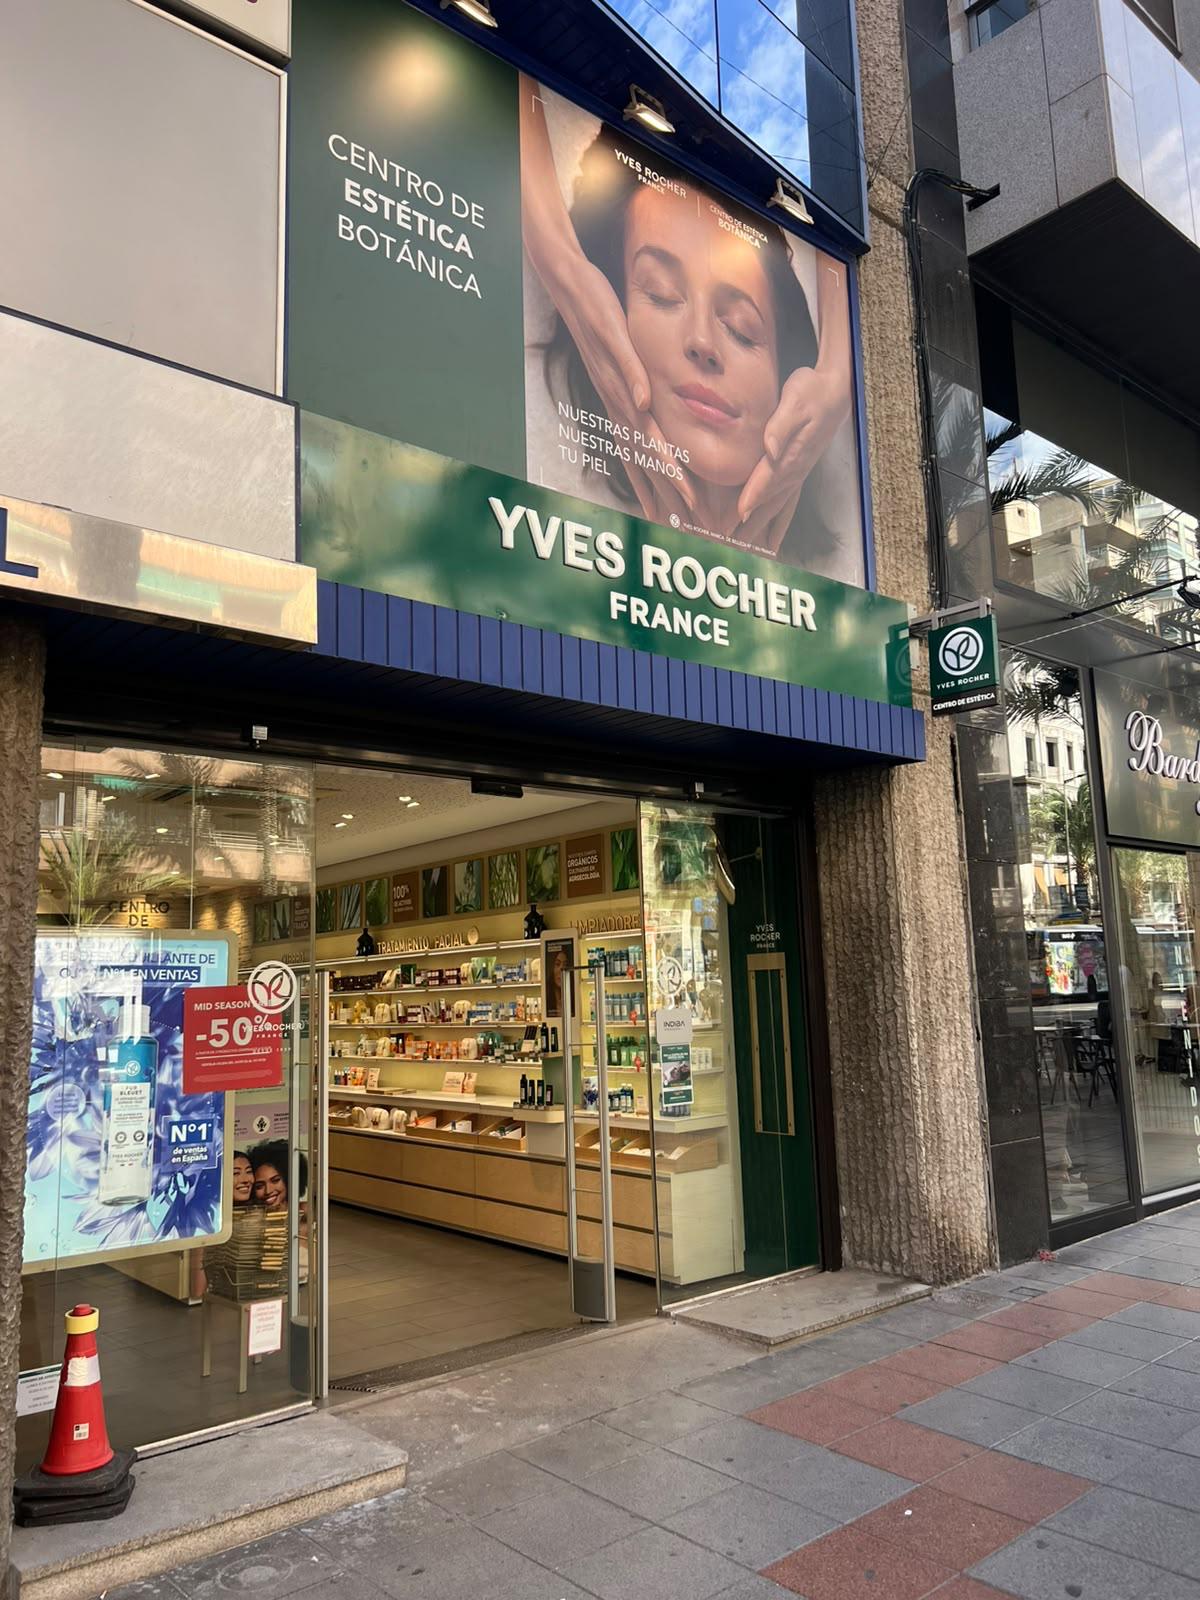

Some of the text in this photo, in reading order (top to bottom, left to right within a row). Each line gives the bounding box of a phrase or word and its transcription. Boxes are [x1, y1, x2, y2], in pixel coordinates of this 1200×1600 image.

[327, 134, 486, 230] CENTRO DE
[614, 148, 687, 199] YVES ROCHER
[638, 174, 665, 195] FRANCE
[344, 178, 474, 260] ESTÉTICA
[709, 203, 733, 223] CENTRO
[734, 217, 743, 229] DE
[718, 217, 761, 249] BOTÁNICA
[338, 214, 482, 300] BOTÁNICA
[558, 401, 690, 464] NUESTRAS PLANTAS
[558, 445, 611, 476] TU PIEL
[559, 423, 684, 481] NUESTRAS MANOS
[488, 496, 818, 632] YVES ROCHER
[609, 590, 730, 647] FRANCE
[936, 673, 990, 690] YVES ROCHER
[933, 692, 996, 711] CENTRO DE ESTÉTICA
[128, 914, 149, 927] DE
[755, 923, 775, 932] YVES
[377, 932, 466, 955] TRATAMIENTO FACIAL
[750, 931, 781, 942] ROCHER
[199, 953, 216, 965] DE
[150, 969, 199, 981] VENTAS
[193, 1003, 213, 1011] MID
[214, 1001, 251, 1010] SEASON
[173, 1146, 208, 1155] de ventas
[182, 1154, 209, 1164] España
